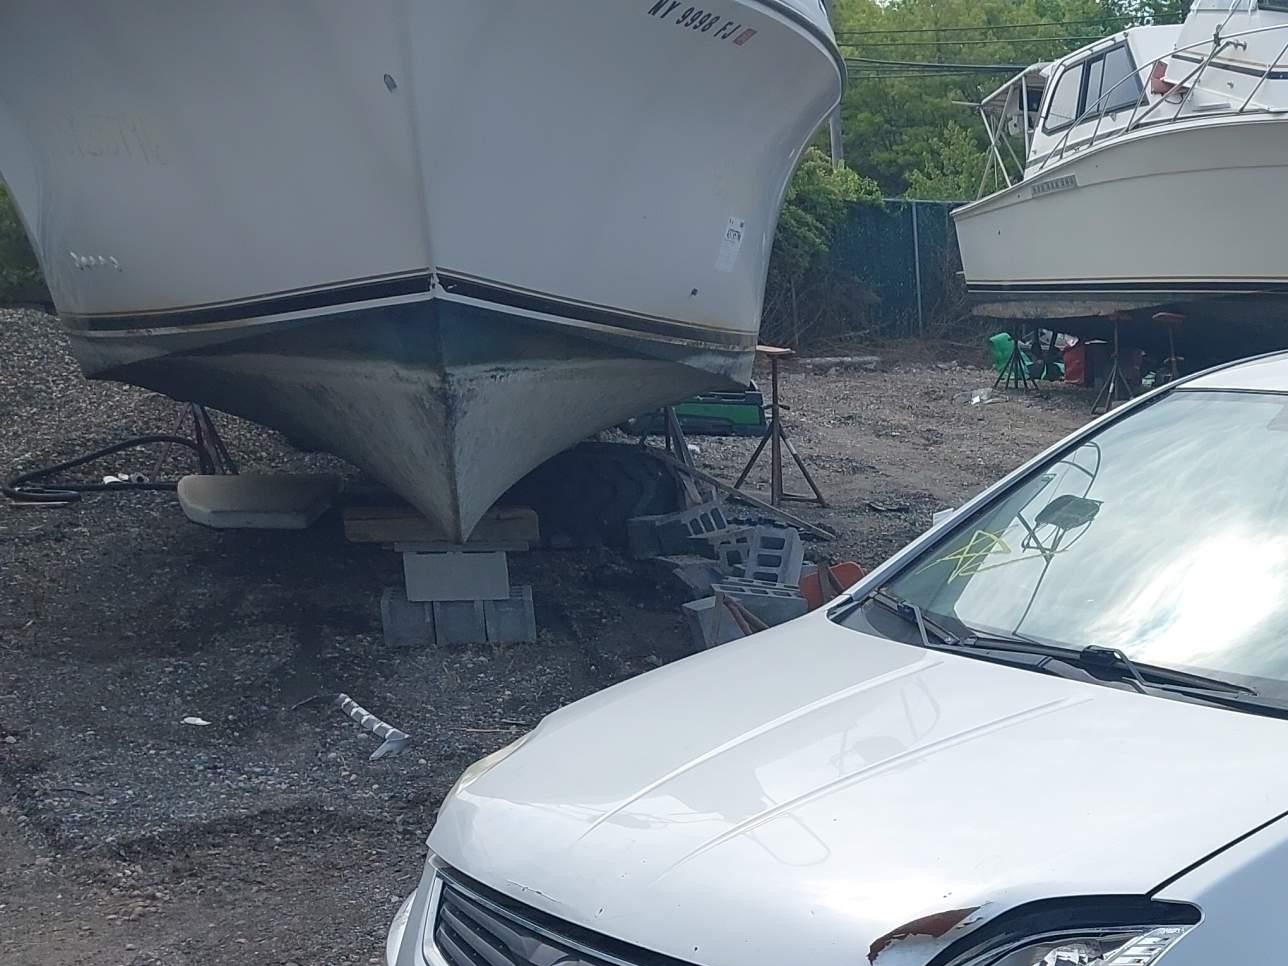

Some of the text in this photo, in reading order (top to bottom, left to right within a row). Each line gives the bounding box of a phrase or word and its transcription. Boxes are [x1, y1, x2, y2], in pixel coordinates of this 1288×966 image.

[648, 0, 681, 18] NY
[676, 7, 720, 32] 9998
[713, 21, 741, 39] FJ
